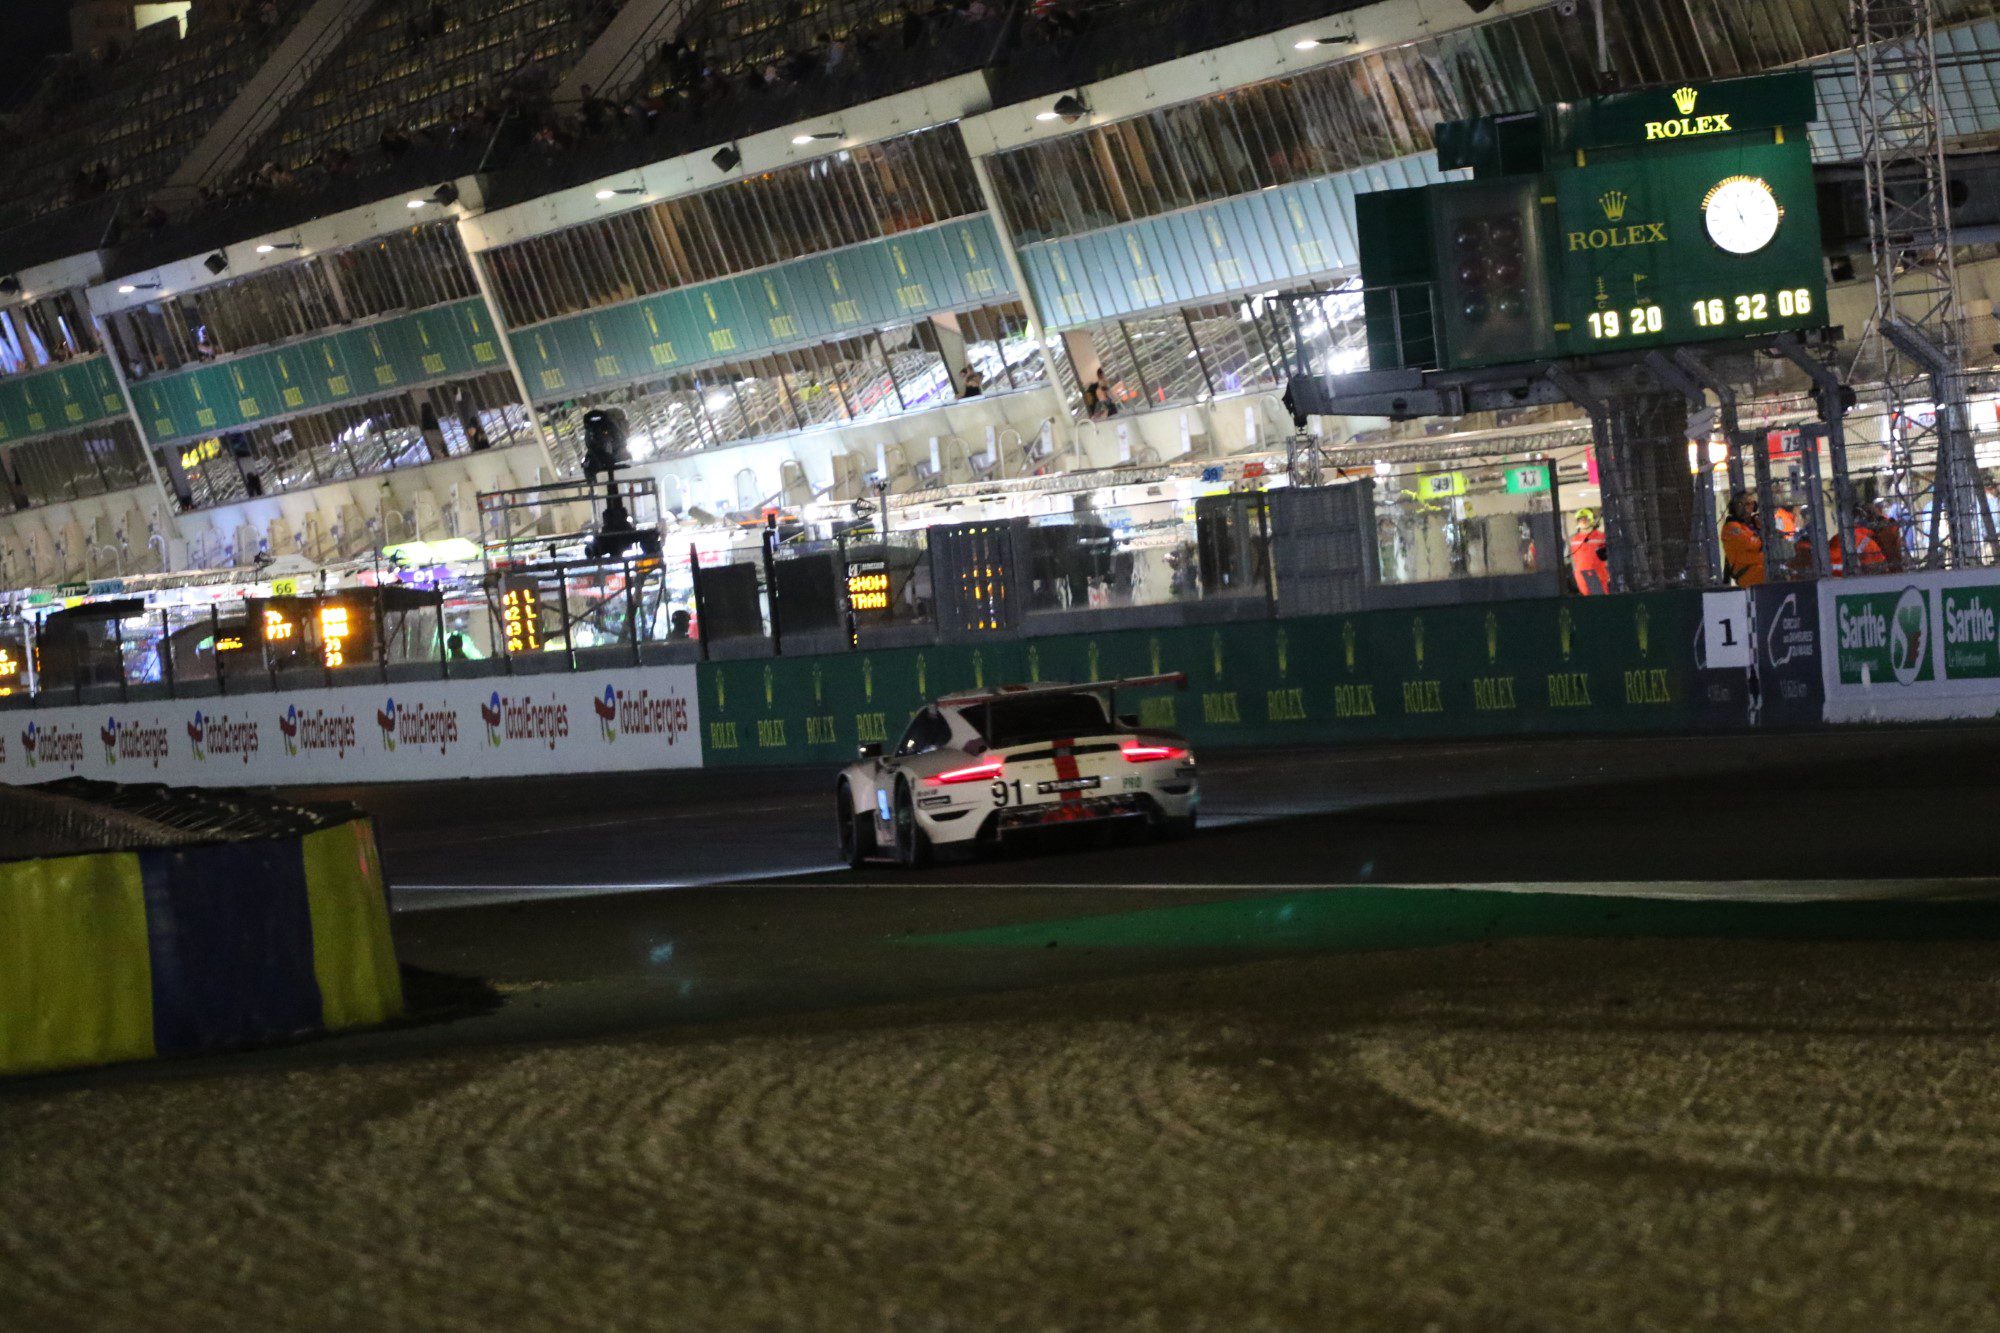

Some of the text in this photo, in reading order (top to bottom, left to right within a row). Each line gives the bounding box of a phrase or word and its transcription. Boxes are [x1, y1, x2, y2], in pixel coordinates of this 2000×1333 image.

[1645, 113, 1732, 140] ROLEX
[1568, 222, 1668, 252] ROLEX
[1588, 305, 1663, 339] 19 20
[1692, 288, 1811, 326] 16 32 06
[276, 582, 292, 595] 66
[1718, 618, 1738, 646] 1
[1840, 602, 1886, 649] Sarthe
[1946, 595, 1995, 644] Sarthe
[1334, 684, 1376, 717] ROLEX
[1402, 680, 1443, 713] ROLEX
[1473, 677, 1516, 711] ROLEX
[1547, 672, 1592, 707] ROLEX
[1624, 668, 1671, 704] ROLEX
[397, 700, 458, 755] TotalEnergies
[502, 691, 568, 751] TotalEnergies
[616, 686, 688, 746] TotalEnergies
[856, 712, 888, 741] ROLEX
[991, 779, 1023, 807] 91
